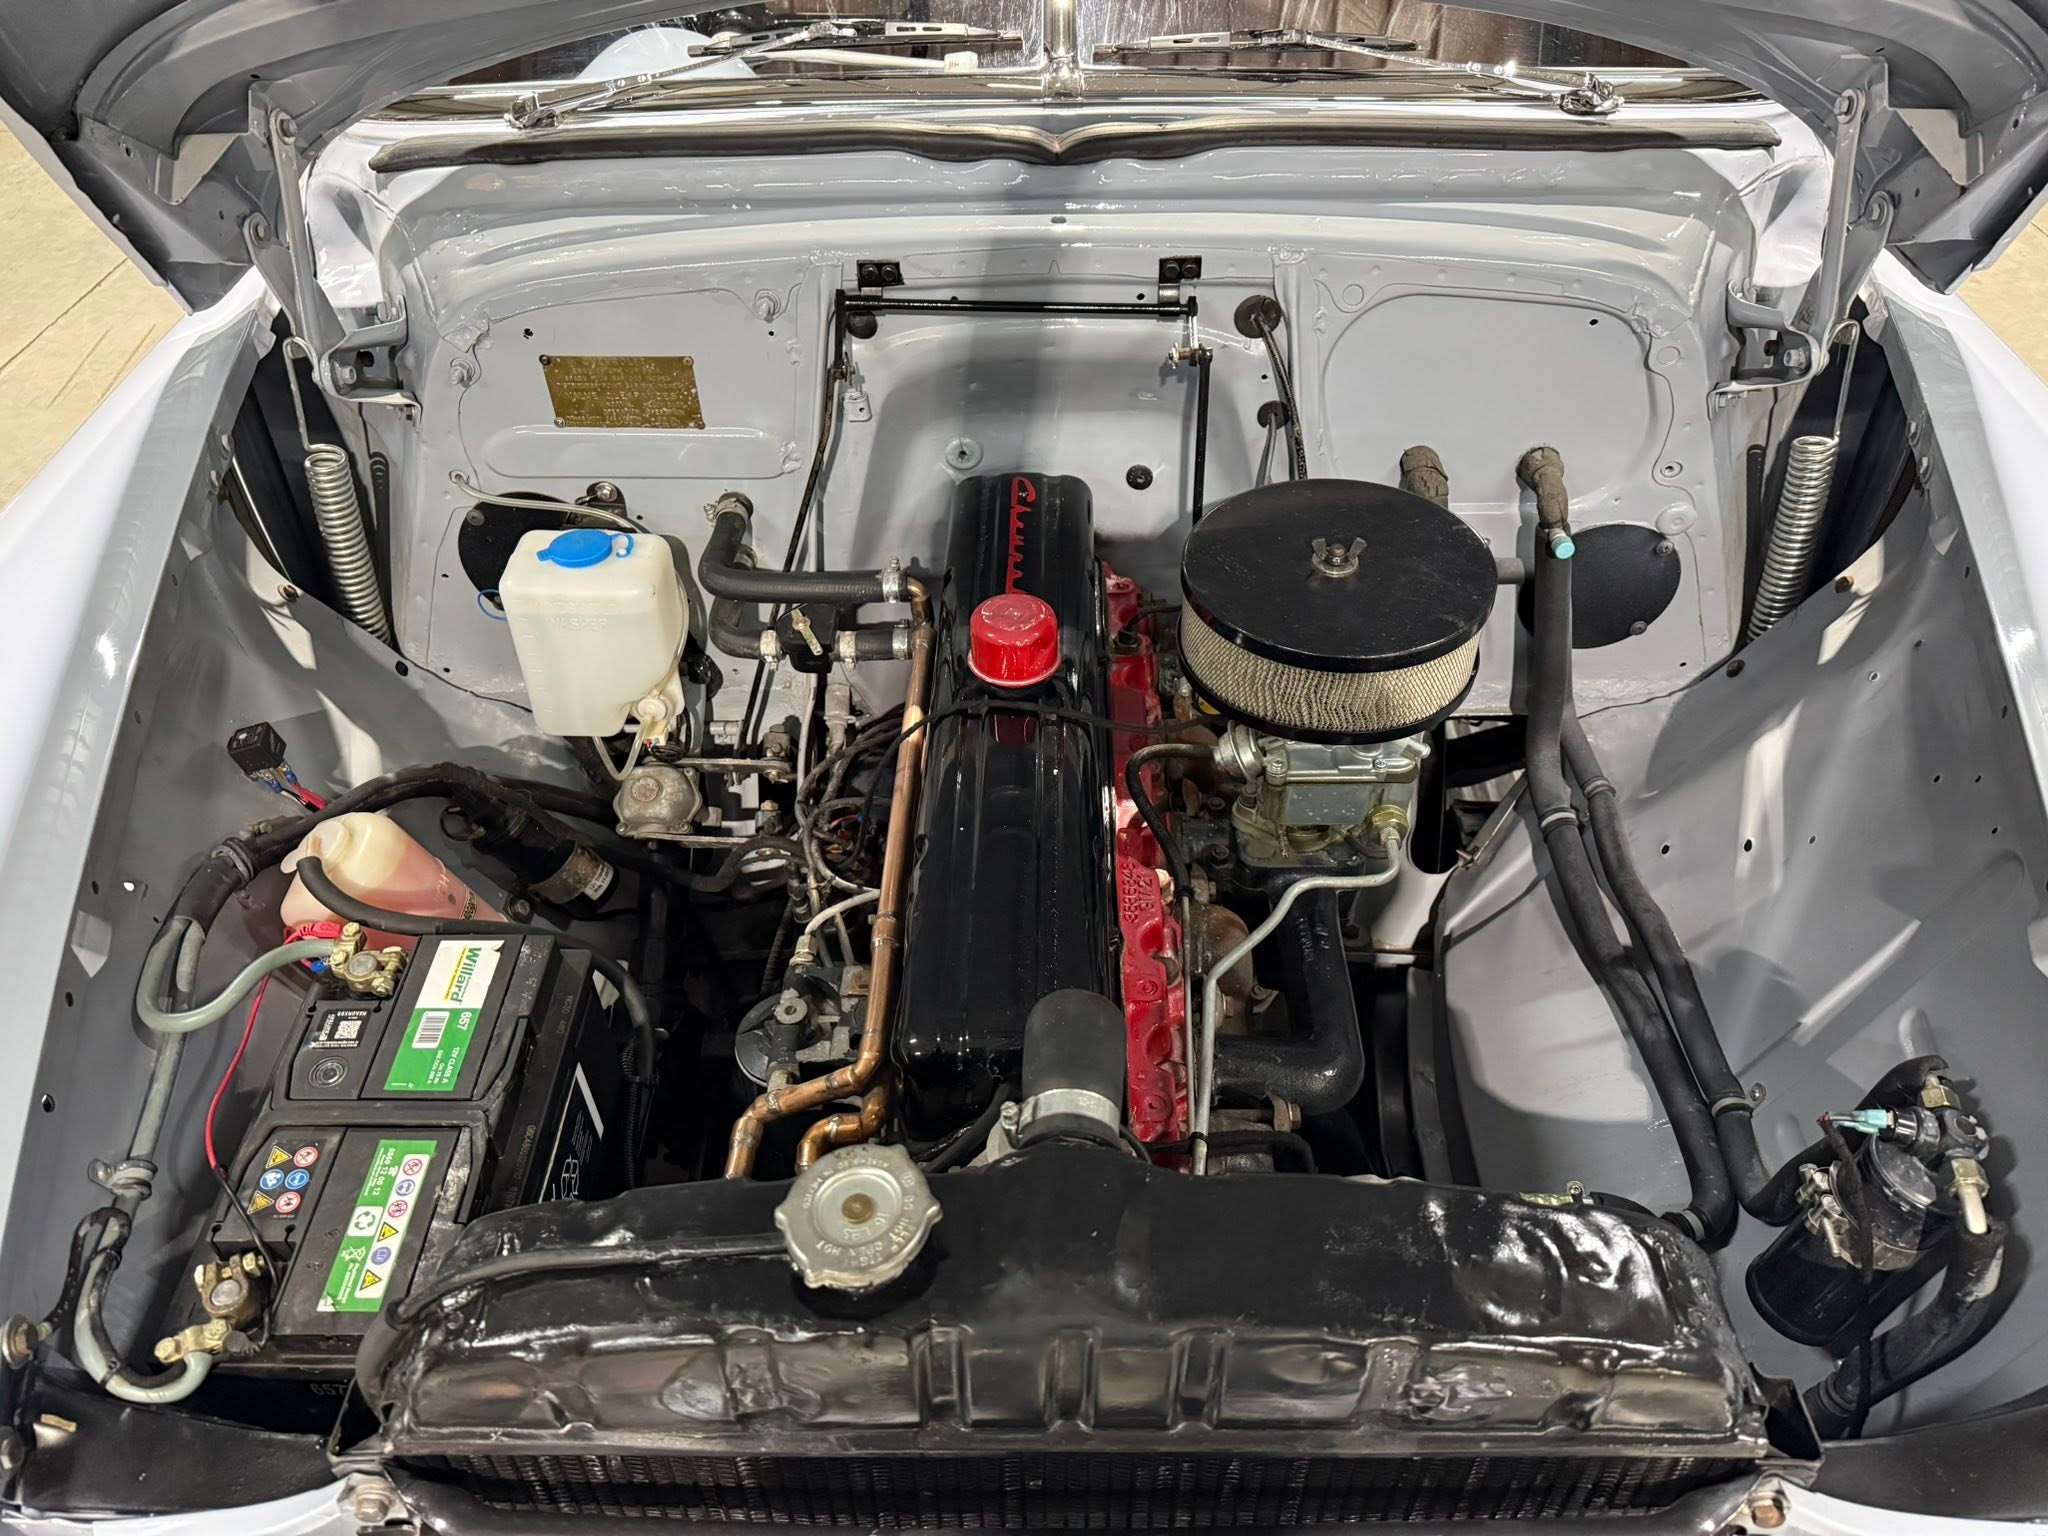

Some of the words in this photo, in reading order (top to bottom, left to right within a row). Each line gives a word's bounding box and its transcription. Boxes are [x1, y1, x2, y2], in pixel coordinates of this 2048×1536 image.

[449, 947, 482, 1003] Willard
[456, 1011, 473, 1031] 657
[451, 1046, 460, 1059] 12V
[444, 1058, 456, 1078] CLASS
[380, 1166, 389, 1175] 12
[376, 1176, 385, 1185] 00
[372, 1187, 381, 1196] 12
[815, 1239, 842, 1256] HOT
